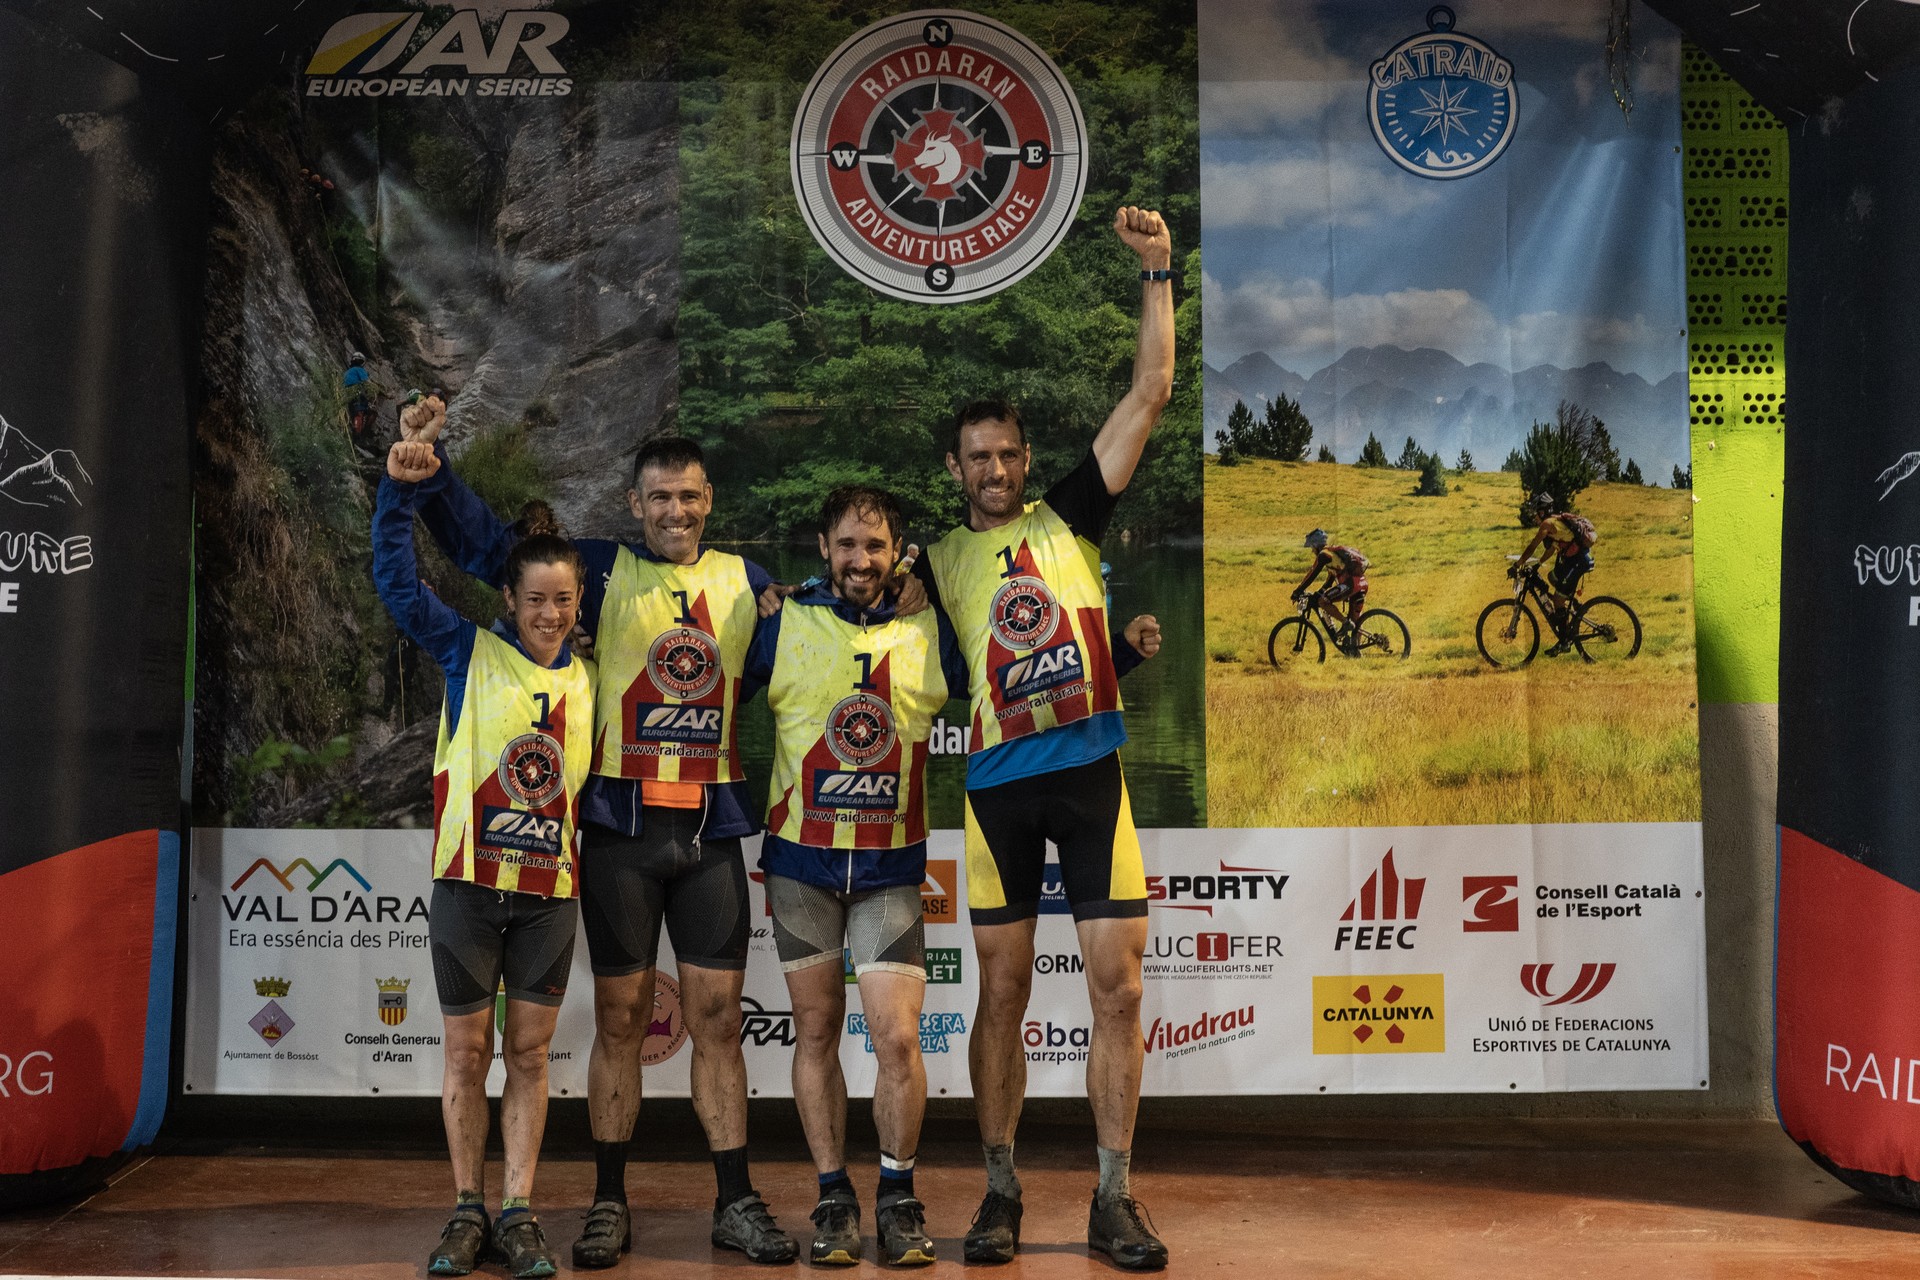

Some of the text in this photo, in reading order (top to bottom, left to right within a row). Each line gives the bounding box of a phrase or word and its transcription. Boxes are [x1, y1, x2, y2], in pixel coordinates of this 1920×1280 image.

[929, 25, 948, 42] N
[860, 50, 1016, 100] RAIDARAN
[1371, 43, 1513, 91] CATRAID
[306, 78, 573, 97] EUROPEAN SERIES
[832, 150, 857, 167] W
[1026, 146, 1043, 163] E
[846, 190, 1035, 261] ADVENTURE RACE
[932, 268, 948, 286] S
[996, 545, 1024, 579] 1
[1000, 586, 1037, 607] RAIDARAN
[672, 590, 698, 624] 1
[665, 636, 707, 651] RAIDARAN
[853, 652, 877, 690] 1
[660, 672, 696, 691] ADVENTURE
[1007, 666, 1081, 698] EUROPEAN SERIES
[995, 681, 1093, 720] www.raidaran.rg
[531, 692, 554, 731] 1
[843, 703, 882, 718] RAIDARAN
[642, 728, 718, 740] EUROPEAN SERIES
[517, 743, 556, 761] RAIDARAN
[621, 743, 730, 760] www.raidaran.org
[818, 795, 894, 805] EUROPEAN SERIES
[485, 832, 532, 848] EUROPEAN
[1146, 875, 1289, 900] SPORTY
[1535, 884, 1681, 899] Consell Català
[221, 895, 298, 922] VAL
[1536, 904, 1559, 918] de
[229, 929, 257, 947] Era
[263, 930, 343, 948] esséncia
[350, 930, 381, 948] des
[1143, 935, 1284, 959] UCIFER
[1334, 925, 1417, 951] FEEC
[1143, 964, 1274, 973] WWW.LUCIFERLIGHTS.NET
[1323, 1006, 1434, 1022] CATALUNYA
[345, 1033, 441, 1045] Conselh Generau
[1166, 1029, 1256, 1060] Portem la natura dins
[224, 1050, 319, 1061] Ajuntament de Bossòst
[373, 1051, 413, 1062] d'Aran
